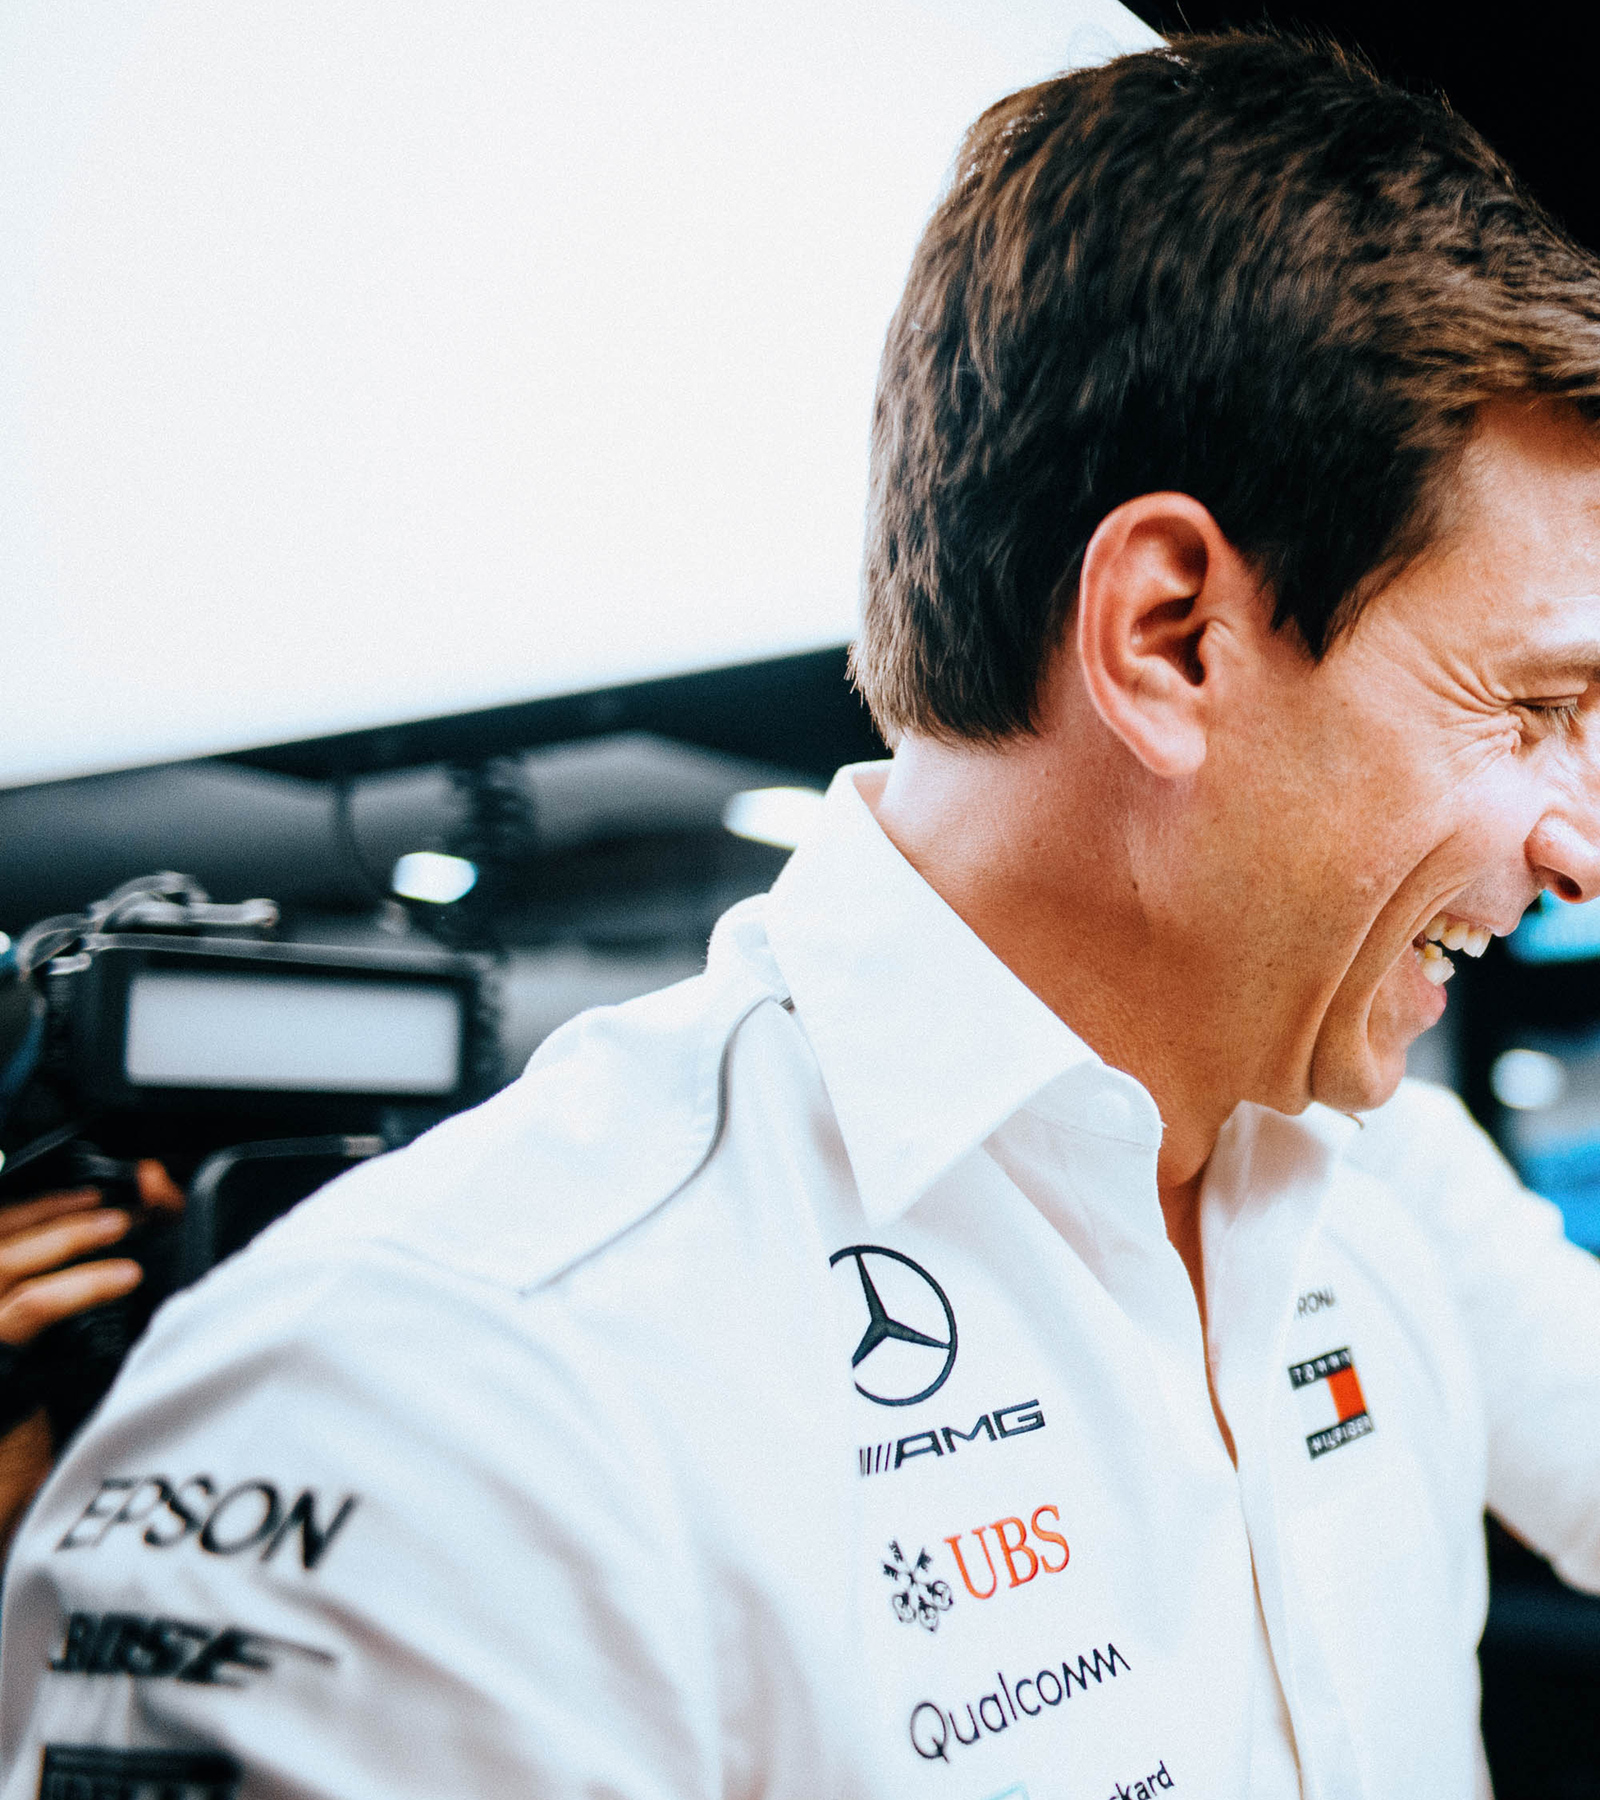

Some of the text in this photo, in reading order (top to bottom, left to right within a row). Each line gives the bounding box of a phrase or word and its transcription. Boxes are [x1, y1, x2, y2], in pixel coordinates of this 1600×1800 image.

[894, 1398, 1046, 1471] AMG
[56, 1474, 364, 1570] EPSON
[943, 1504, 1070, 1600] UBS
[909, 1642, 1131, 1764] Qualcomm
